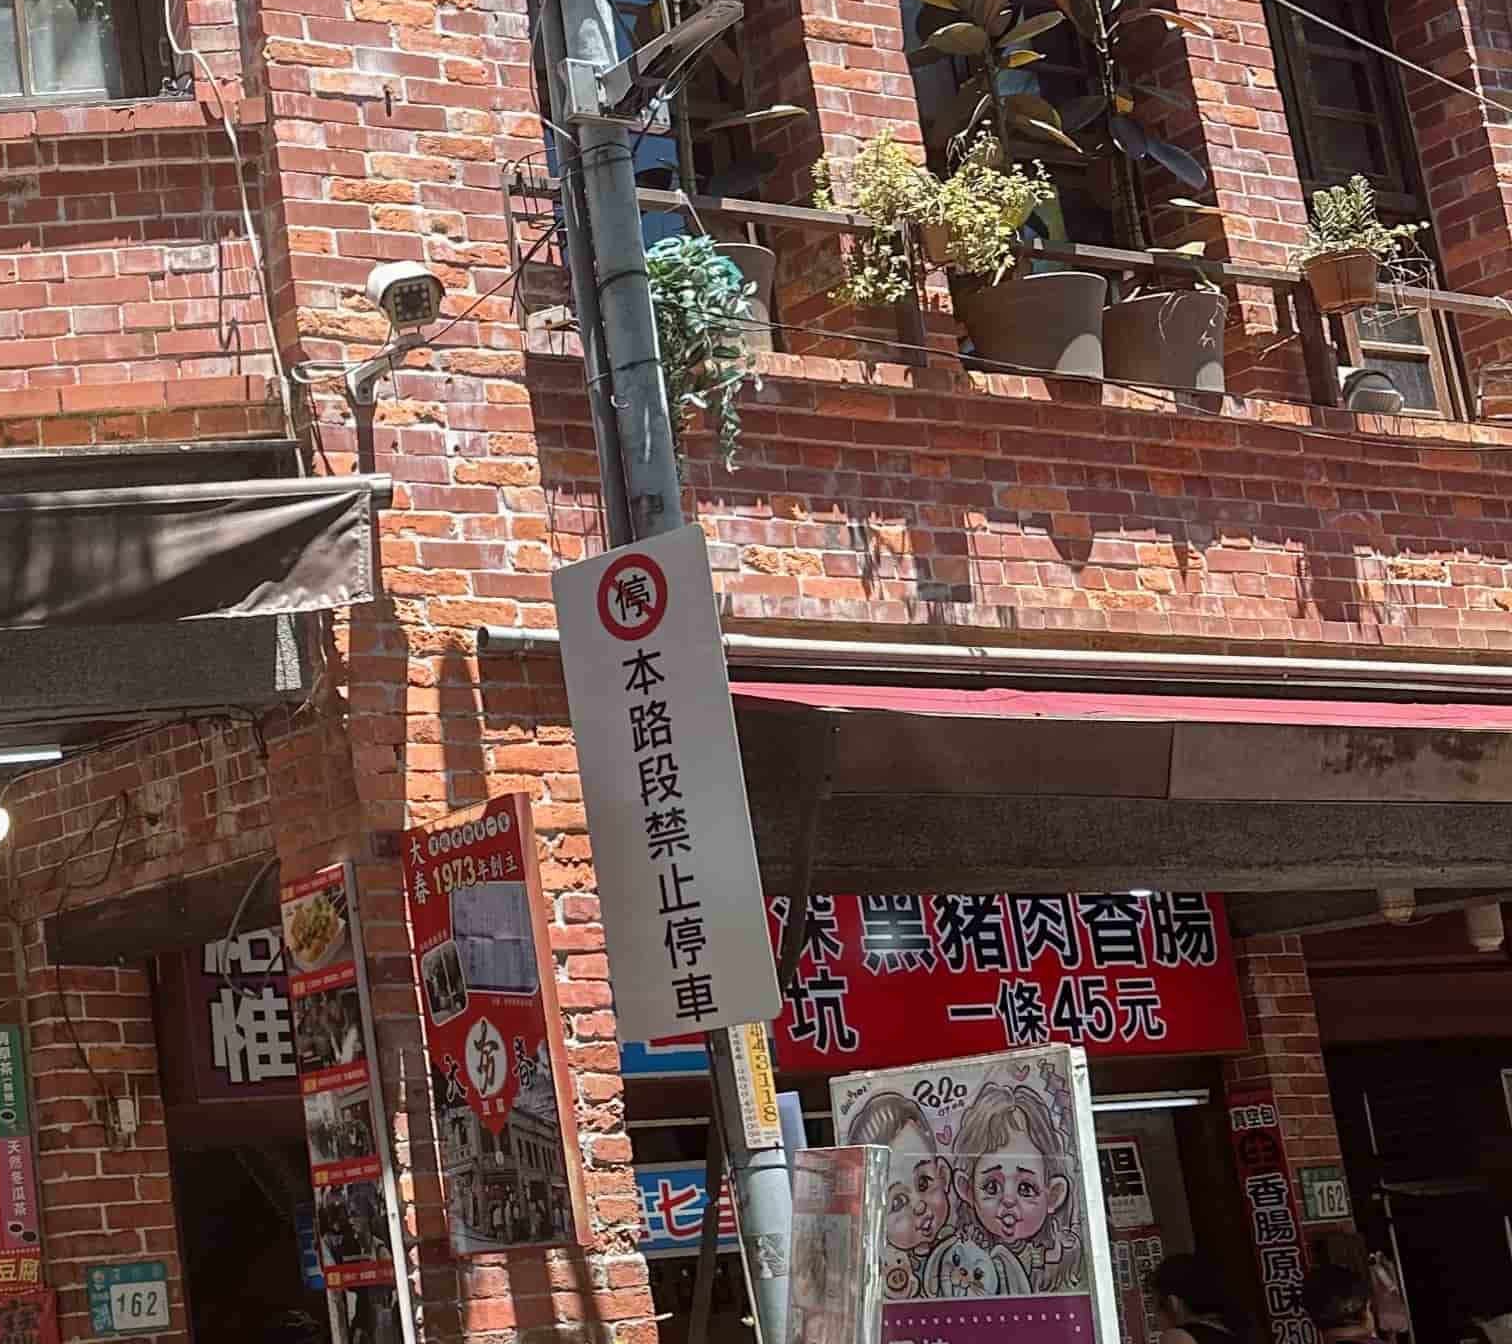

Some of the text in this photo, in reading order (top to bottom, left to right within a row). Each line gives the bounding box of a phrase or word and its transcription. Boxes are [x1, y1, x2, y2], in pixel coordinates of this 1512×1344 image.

[614, 573, 654, 622] 停
[622, 646, 720, 1023] 本路段禁止停車
[409, 837, 430, 904] 大春
[432, 851, 518, 896] 1973年創立
[858, 895, 1216, 974] 黑豬肉香腸
[947, 977, 1167, 1044] 一條45元
[913, 1077, 967, 1108] 2020
[7, 1139, 27, 1217] 天然冬瓜茶
[1318, 1184, 1345, 1213] 162
[116, 1291, 157, 1317] 162
